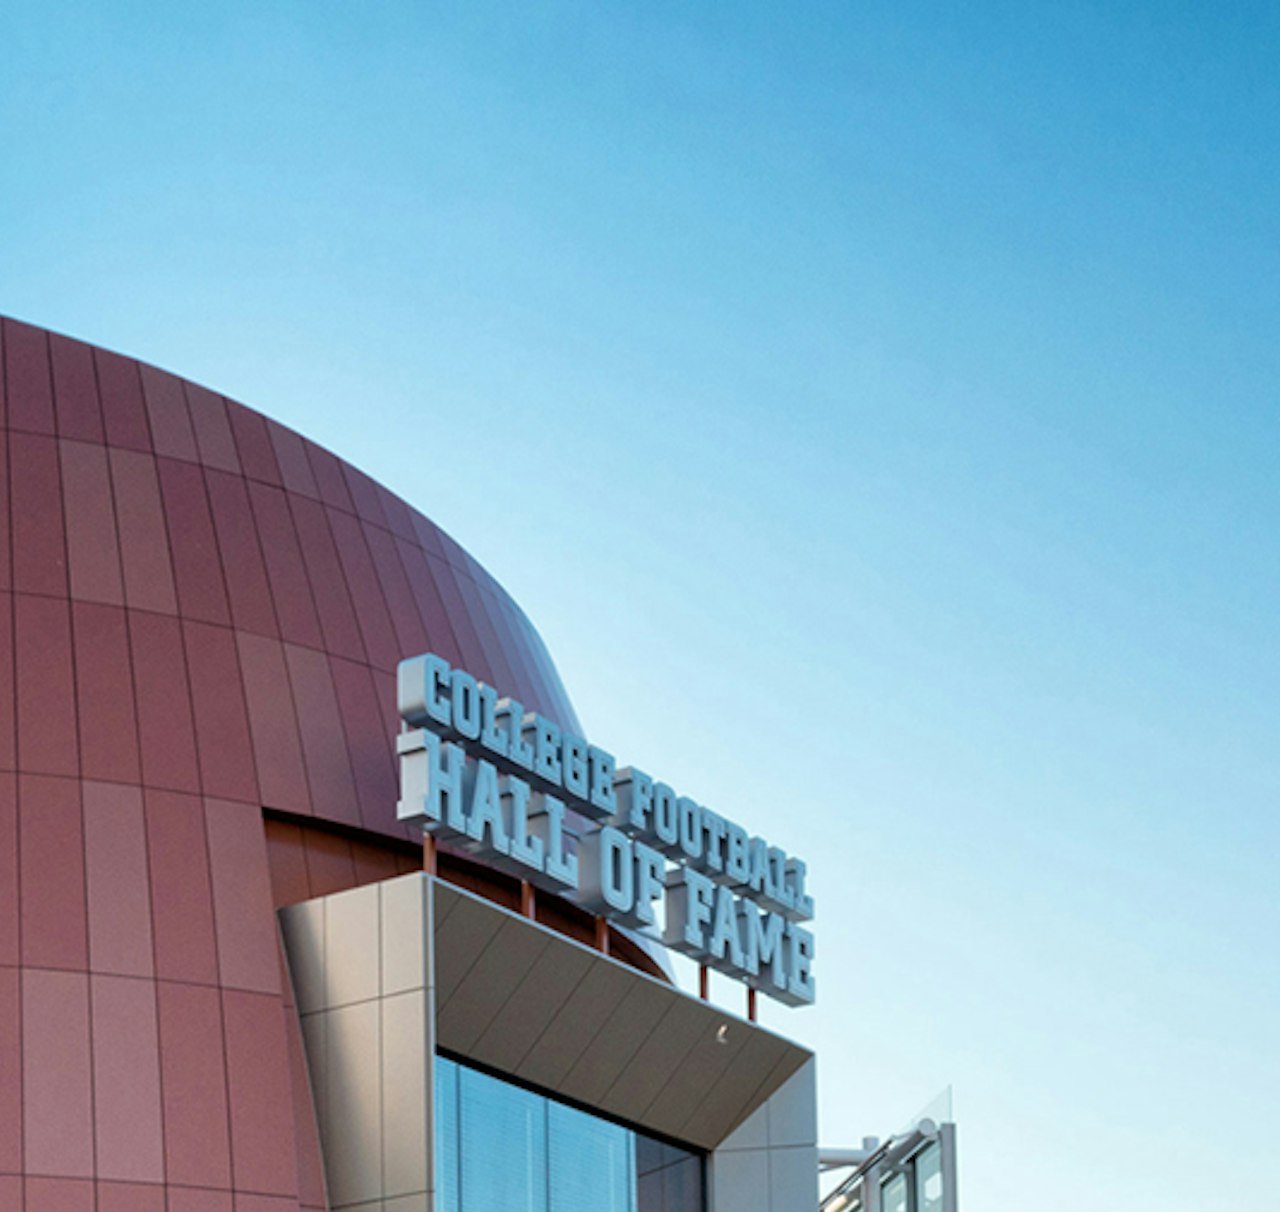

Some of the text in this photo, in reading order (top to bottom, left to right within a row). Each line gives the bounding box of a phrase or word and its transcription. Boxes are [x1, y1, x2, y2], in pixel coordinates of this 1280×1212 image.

[420, 654, 815, 921] COLLEGE FOOTBALL
[422, 729, 816, 1003] HALL OF FAME
